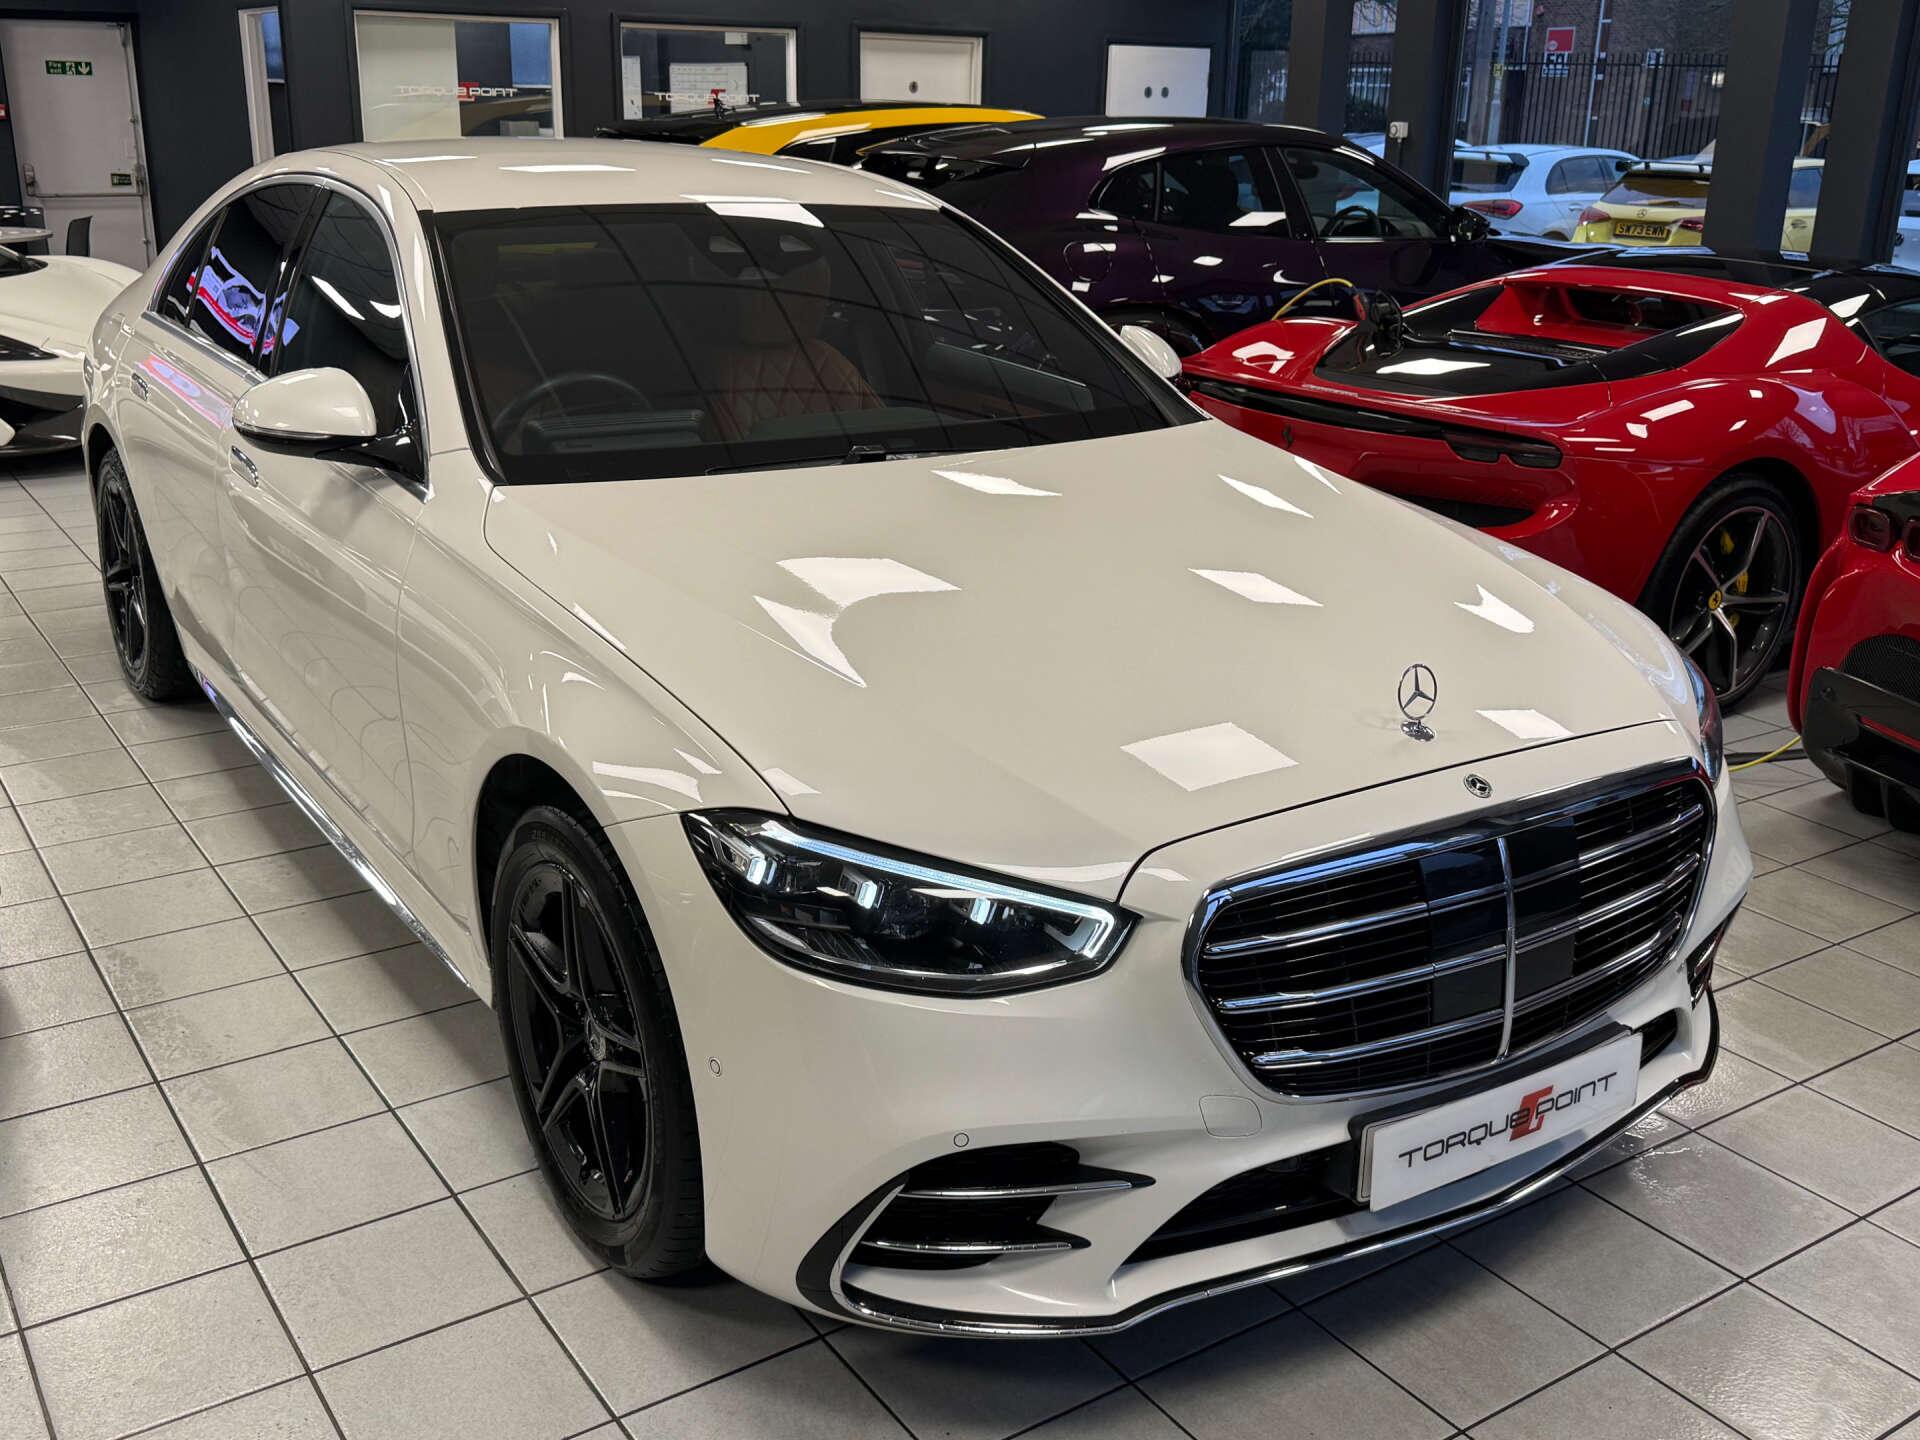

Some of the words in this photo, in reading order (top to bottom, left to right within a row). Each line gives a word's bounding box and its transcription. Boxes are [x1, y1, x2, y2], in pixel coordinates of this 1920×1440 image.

[654, 91, 717, 103] TOQUE
[1398, 1107, 1530, 1168] TORQUE
[1535, 1071, 1618, 1119] POINT
